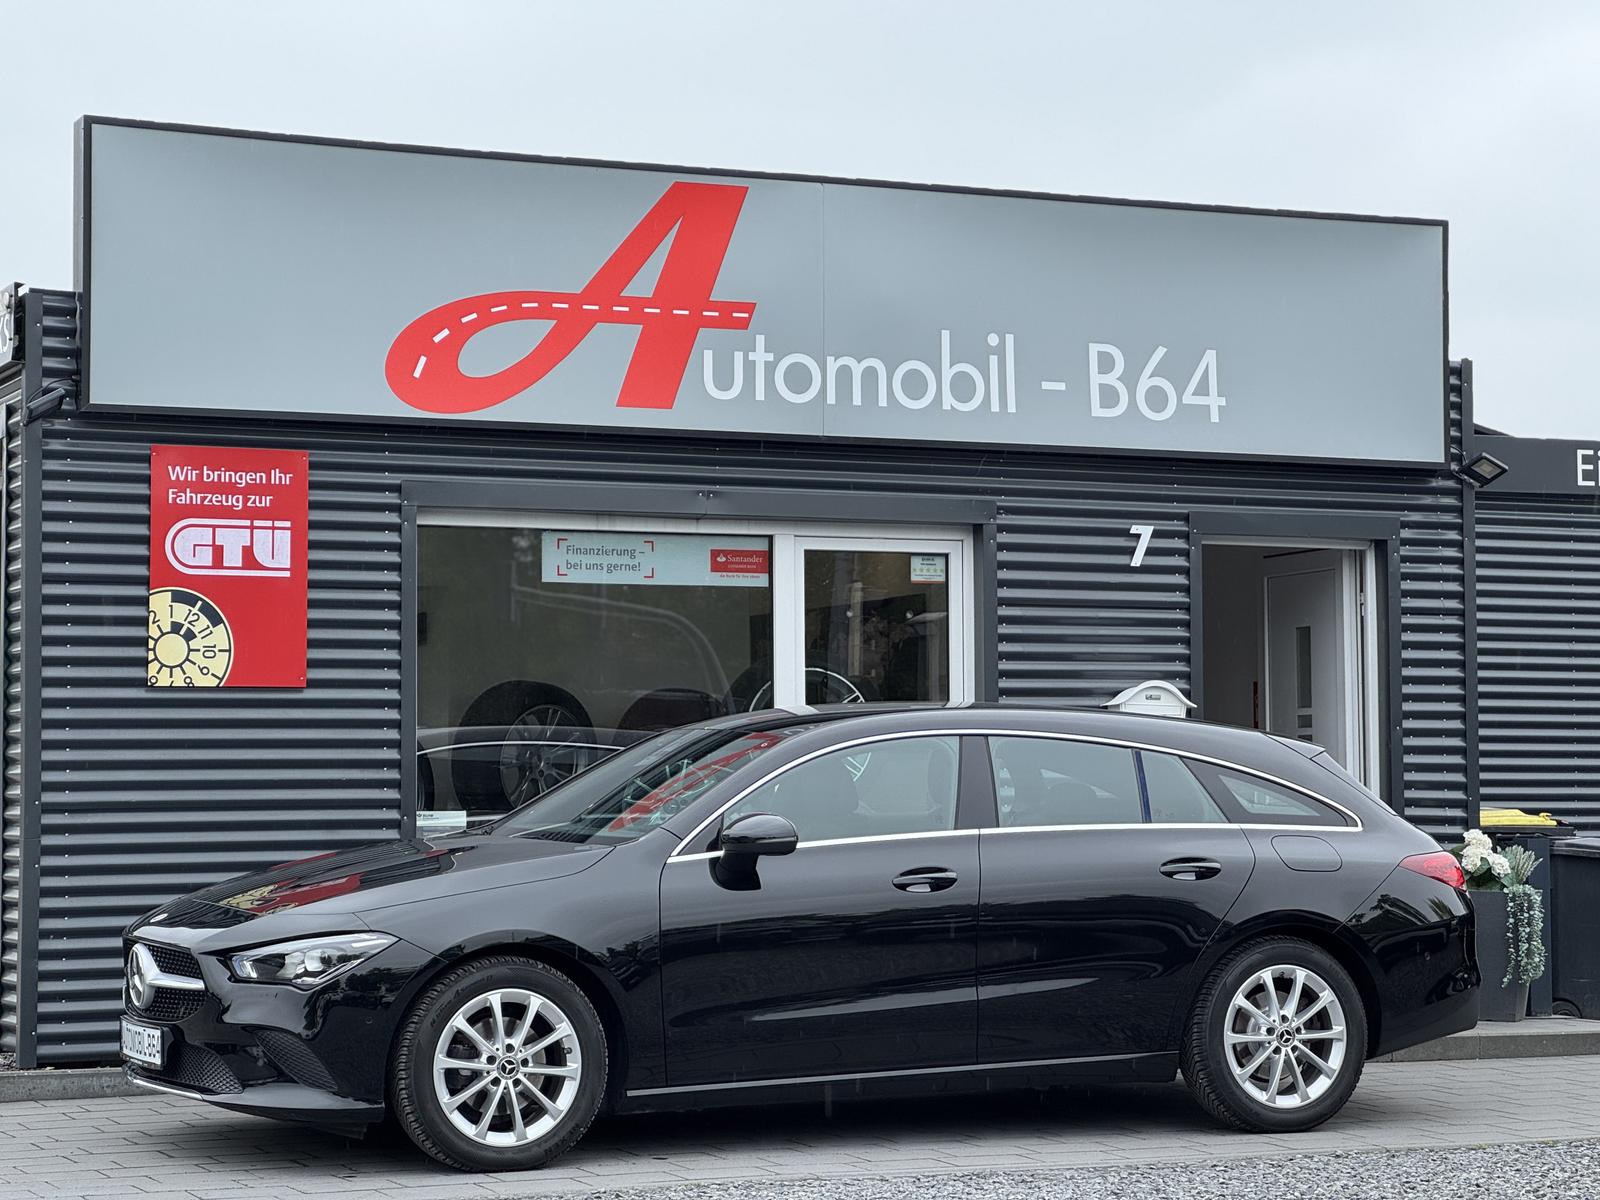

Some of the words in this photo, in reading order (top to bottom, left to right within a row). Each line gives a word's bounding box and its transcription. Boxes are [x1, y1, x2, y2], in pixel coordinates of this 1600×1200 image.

[1088, 342, 1227, 423] B64
[168, 465, 199, 481] Wir
[203, 466, 266, 487] bringen
[270, 469, 293, 485] Ihr
[168, 488, 243, 510] Fahrzeug
[247, 494, 273, 507] zur
[172, 520, 292, 569] GTÜ
[566, 545, 636, 559] Finanzierung
[1129, 525, 1154, 567] 7
[566, 560, 582, 570] bei
[585, 562, 604, 571] uns
[606, 562, 641, 573] gerne!
[727, 554, 763, 563] Santander
[184, 608, 201, 627] 12
[198, 624, 213, 639] 11
[202, 644, 217, 659] 10
